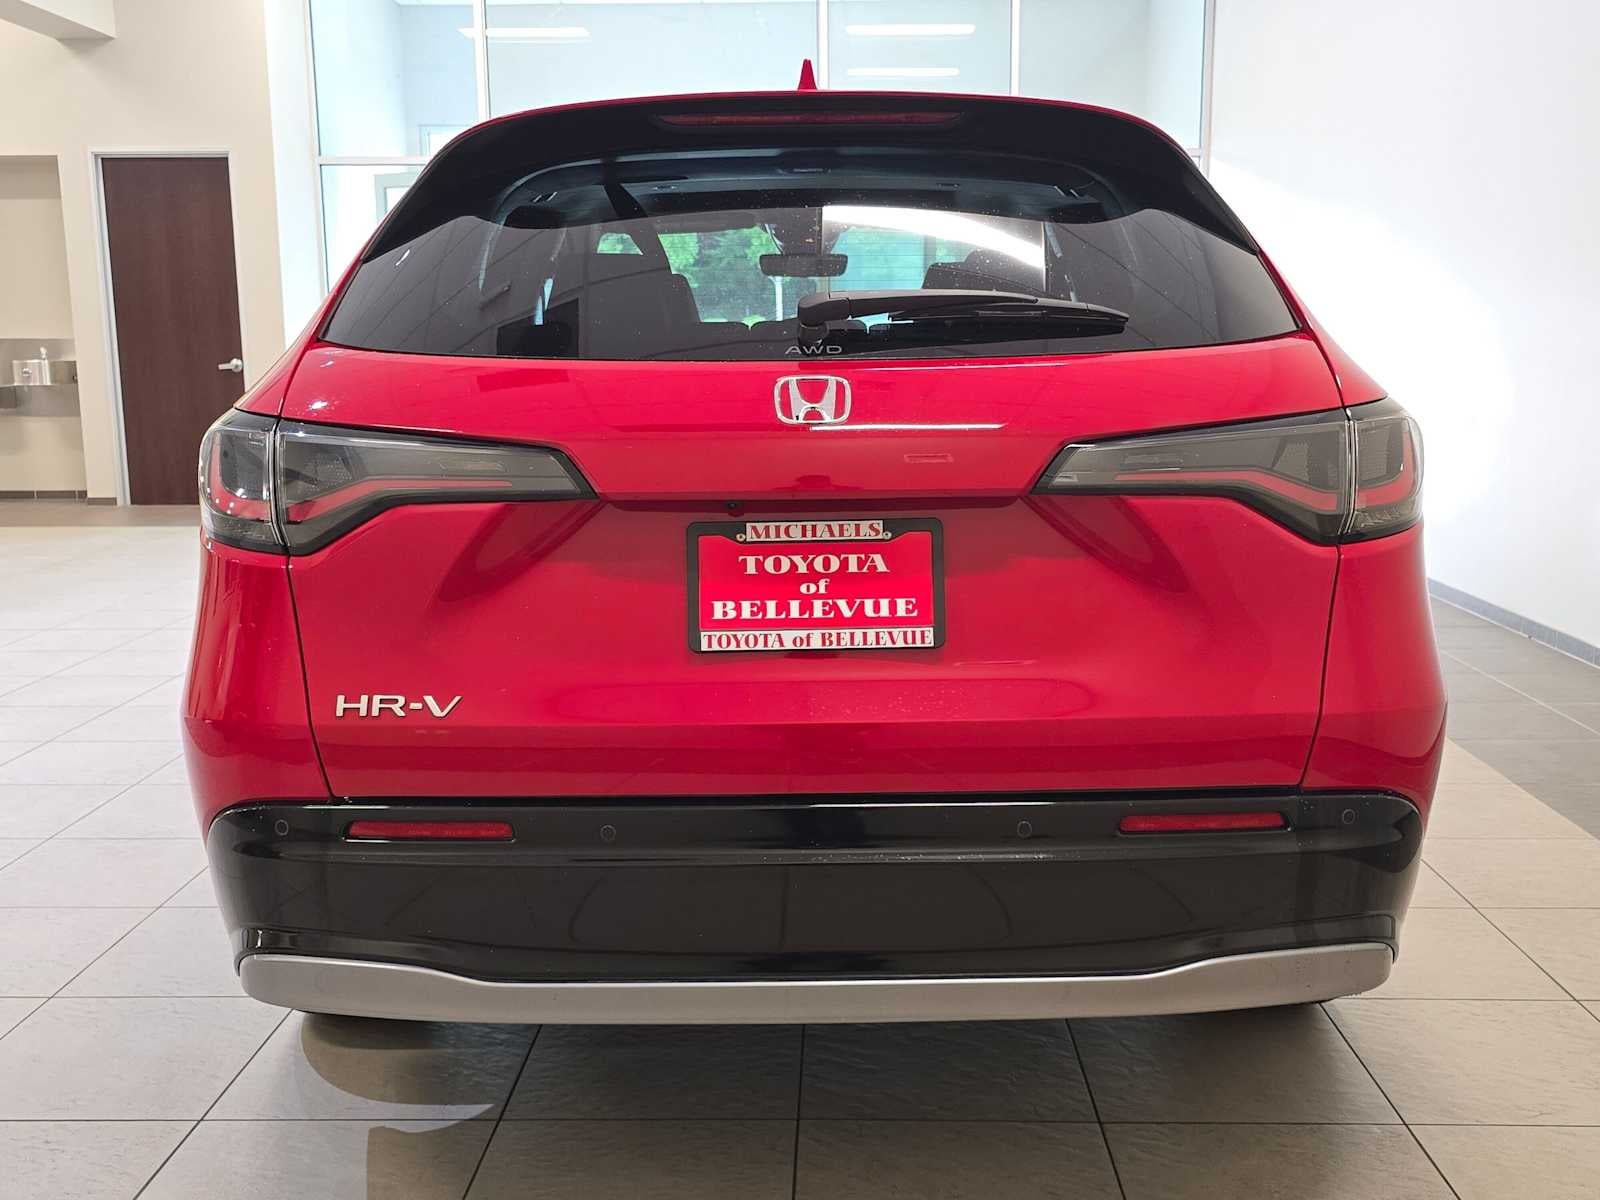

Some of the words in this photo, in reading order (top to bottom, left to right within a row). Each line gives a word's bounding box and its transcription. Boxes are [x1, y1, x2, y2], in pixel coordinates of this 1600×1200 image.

[785, 345, 842, 354] AWD
[749, 522, 881, 539] MICHAELS
[738, 553, 890, 575] TOYOTA
[800, 578, 830, 595] of
[711, 597, 918, 620] BELLEVUE
[703, 632, 786, 649] TOYOTA
[792, 632, 815, 648] of
[820, 629, 932, 647] BELLEVUE
[335, 694, 462, 718] HR-V
